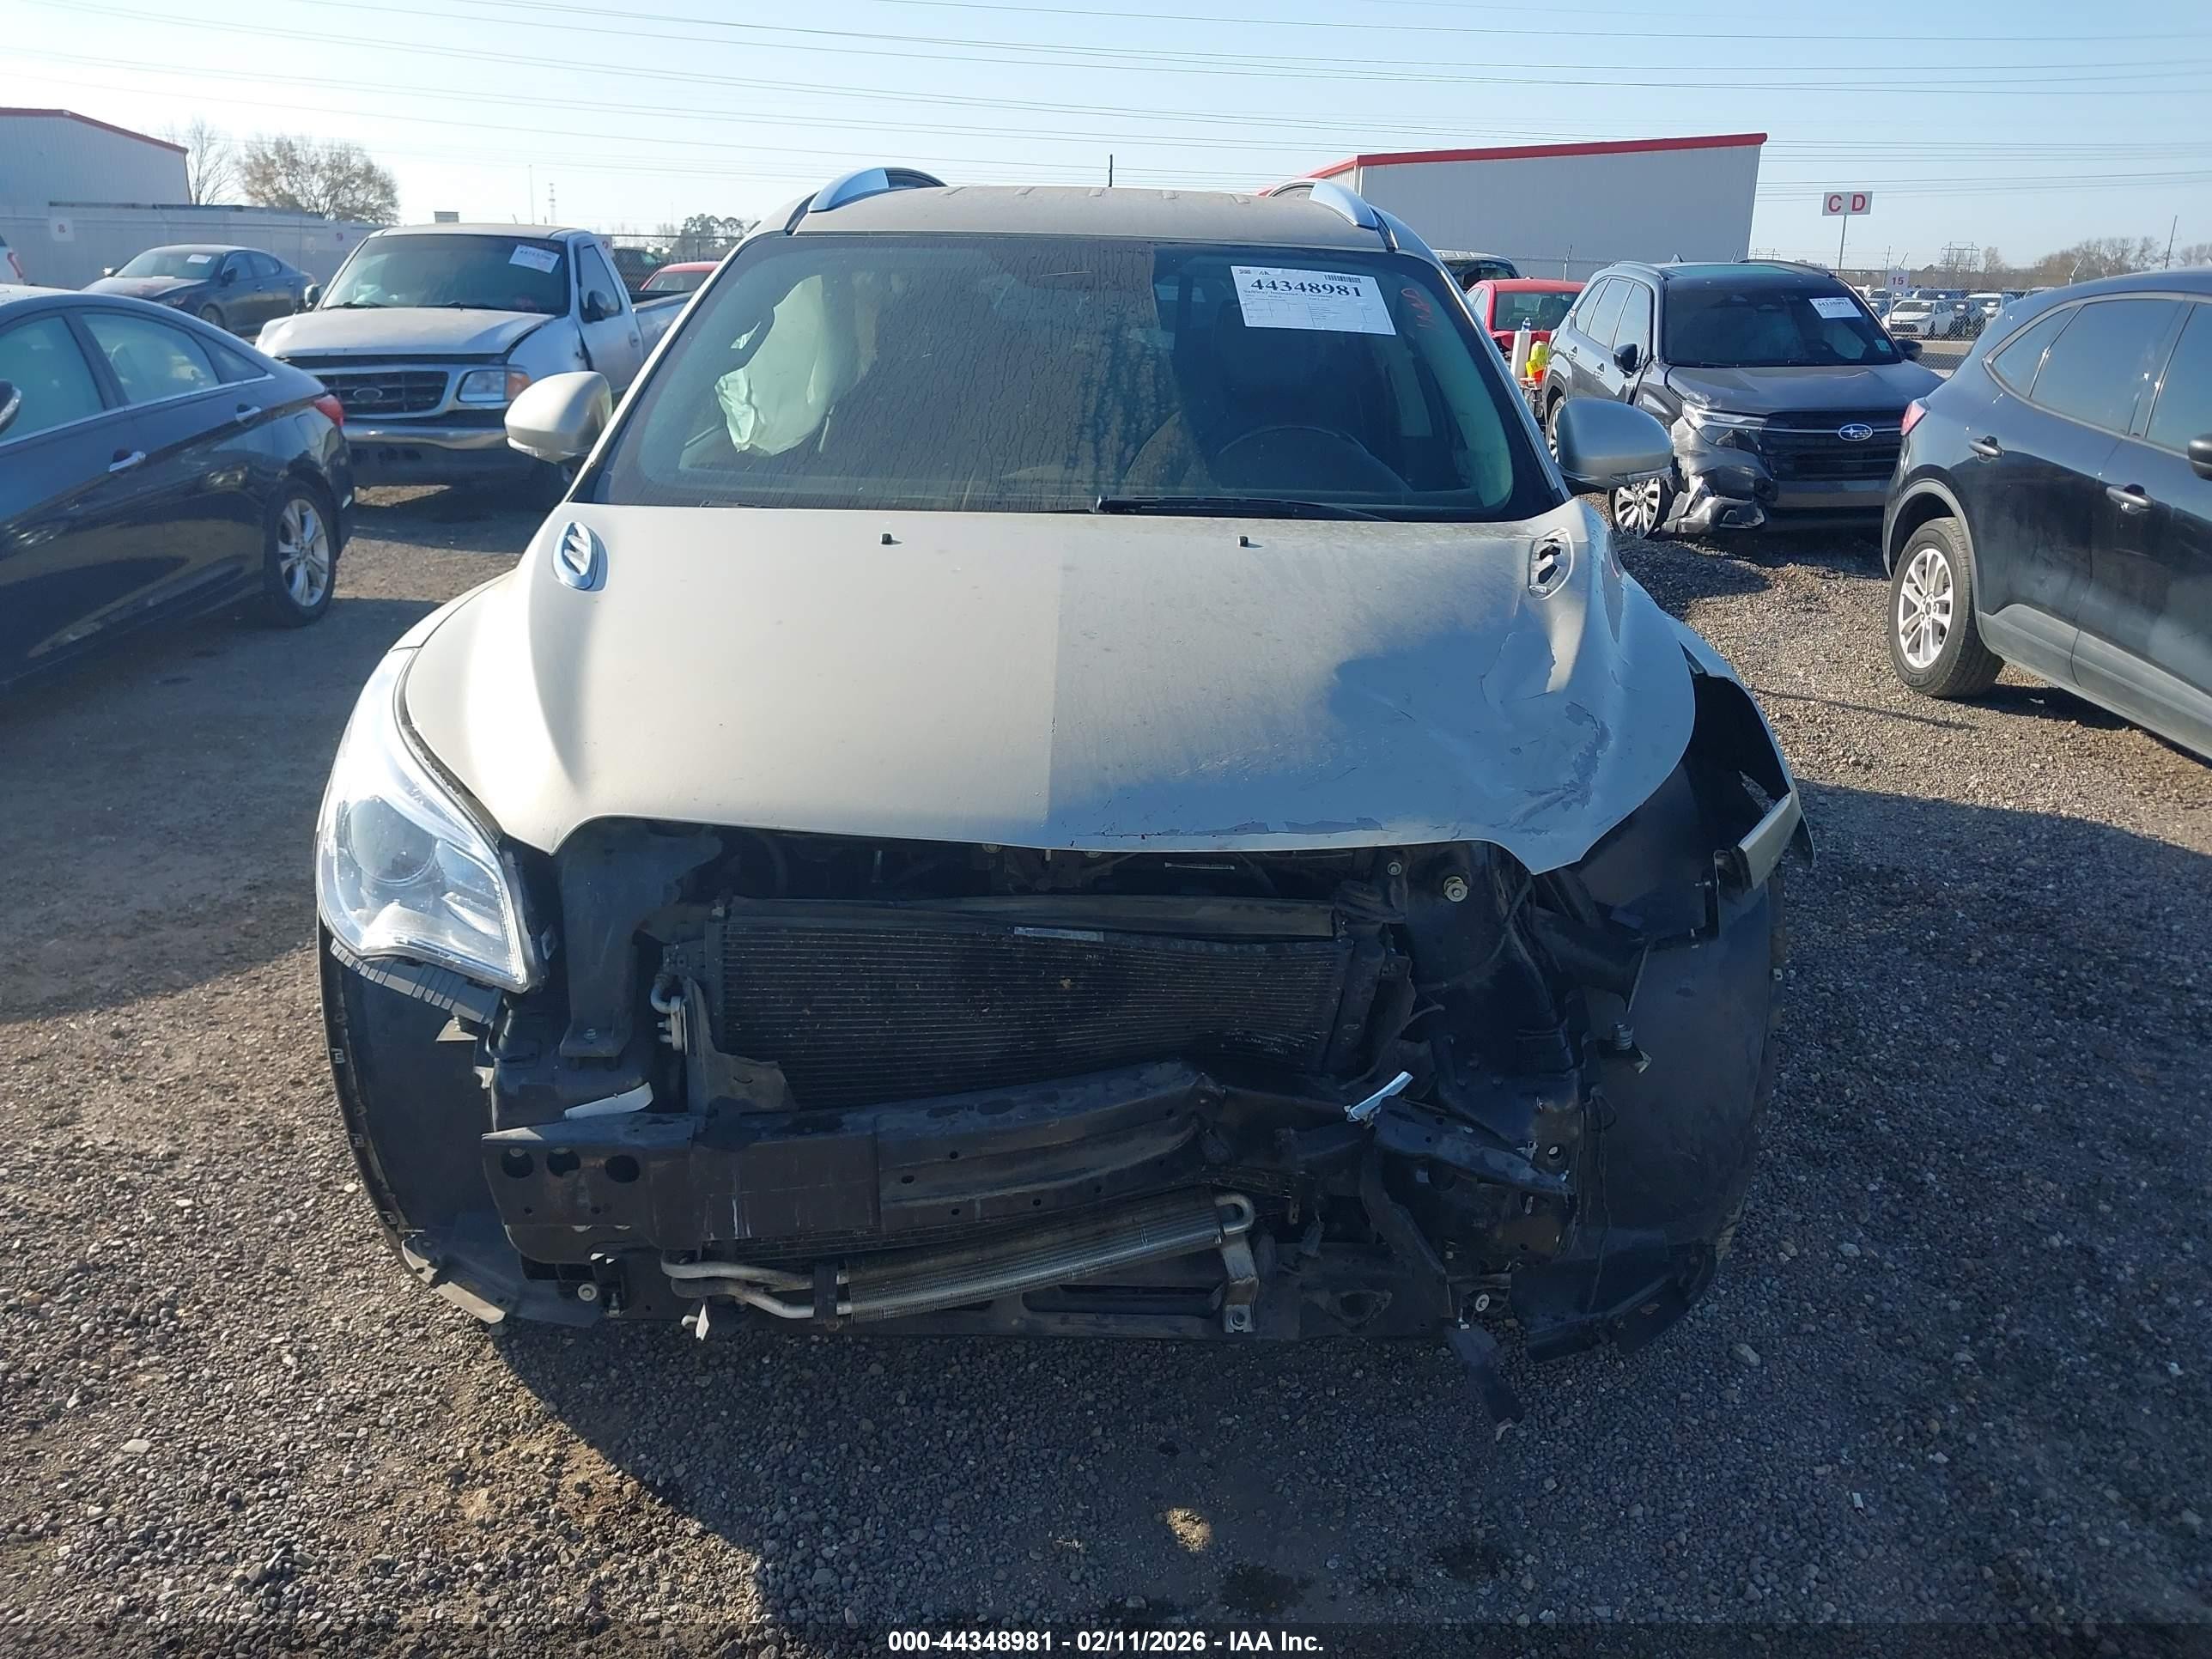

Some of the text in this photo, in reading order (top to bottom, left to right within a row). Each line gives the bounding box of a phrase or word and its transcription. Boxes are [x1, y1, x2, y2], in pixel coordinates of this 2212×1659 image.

[1828, 193, 1866, 213] C D
[1250, 278, 1363, 298] 44348981
[1892, 276, 1905, 286] 15
